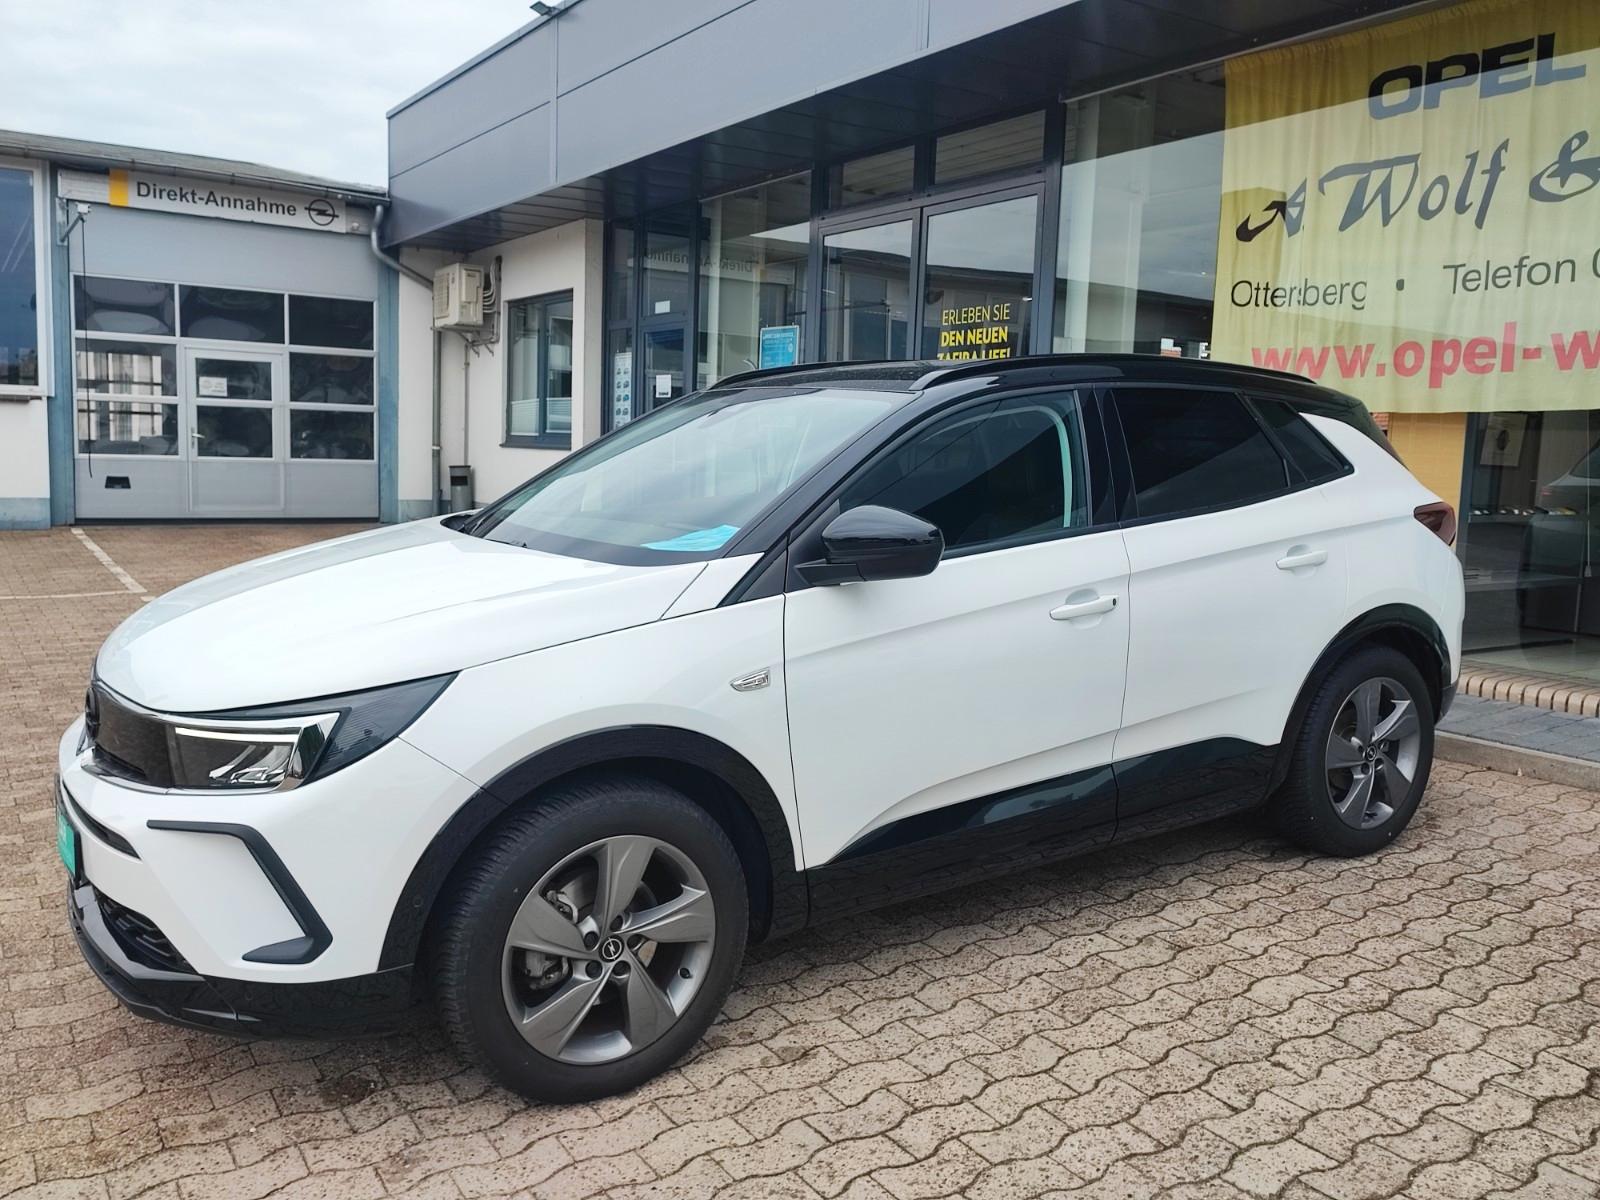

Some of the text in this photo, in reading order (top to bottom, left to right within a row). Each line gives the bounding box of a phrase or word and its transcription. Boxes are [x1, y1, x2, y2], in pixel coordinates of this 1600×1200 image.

[1368, 32, 1587, 120] OPEL
[136, 181, 297, 216] Direkt-Annahme
[1318, 138, 1509, 232] Wolf
[1529, 130, 1600, 202] &
[1443, 255, 1576, 294] Telefon
[942, 303, 1011, 326] ERLEBEN SIE
[941, 325, 1008, 347] DEN NEUEN
[1251, 321, 1600, 389] www.opel-w
